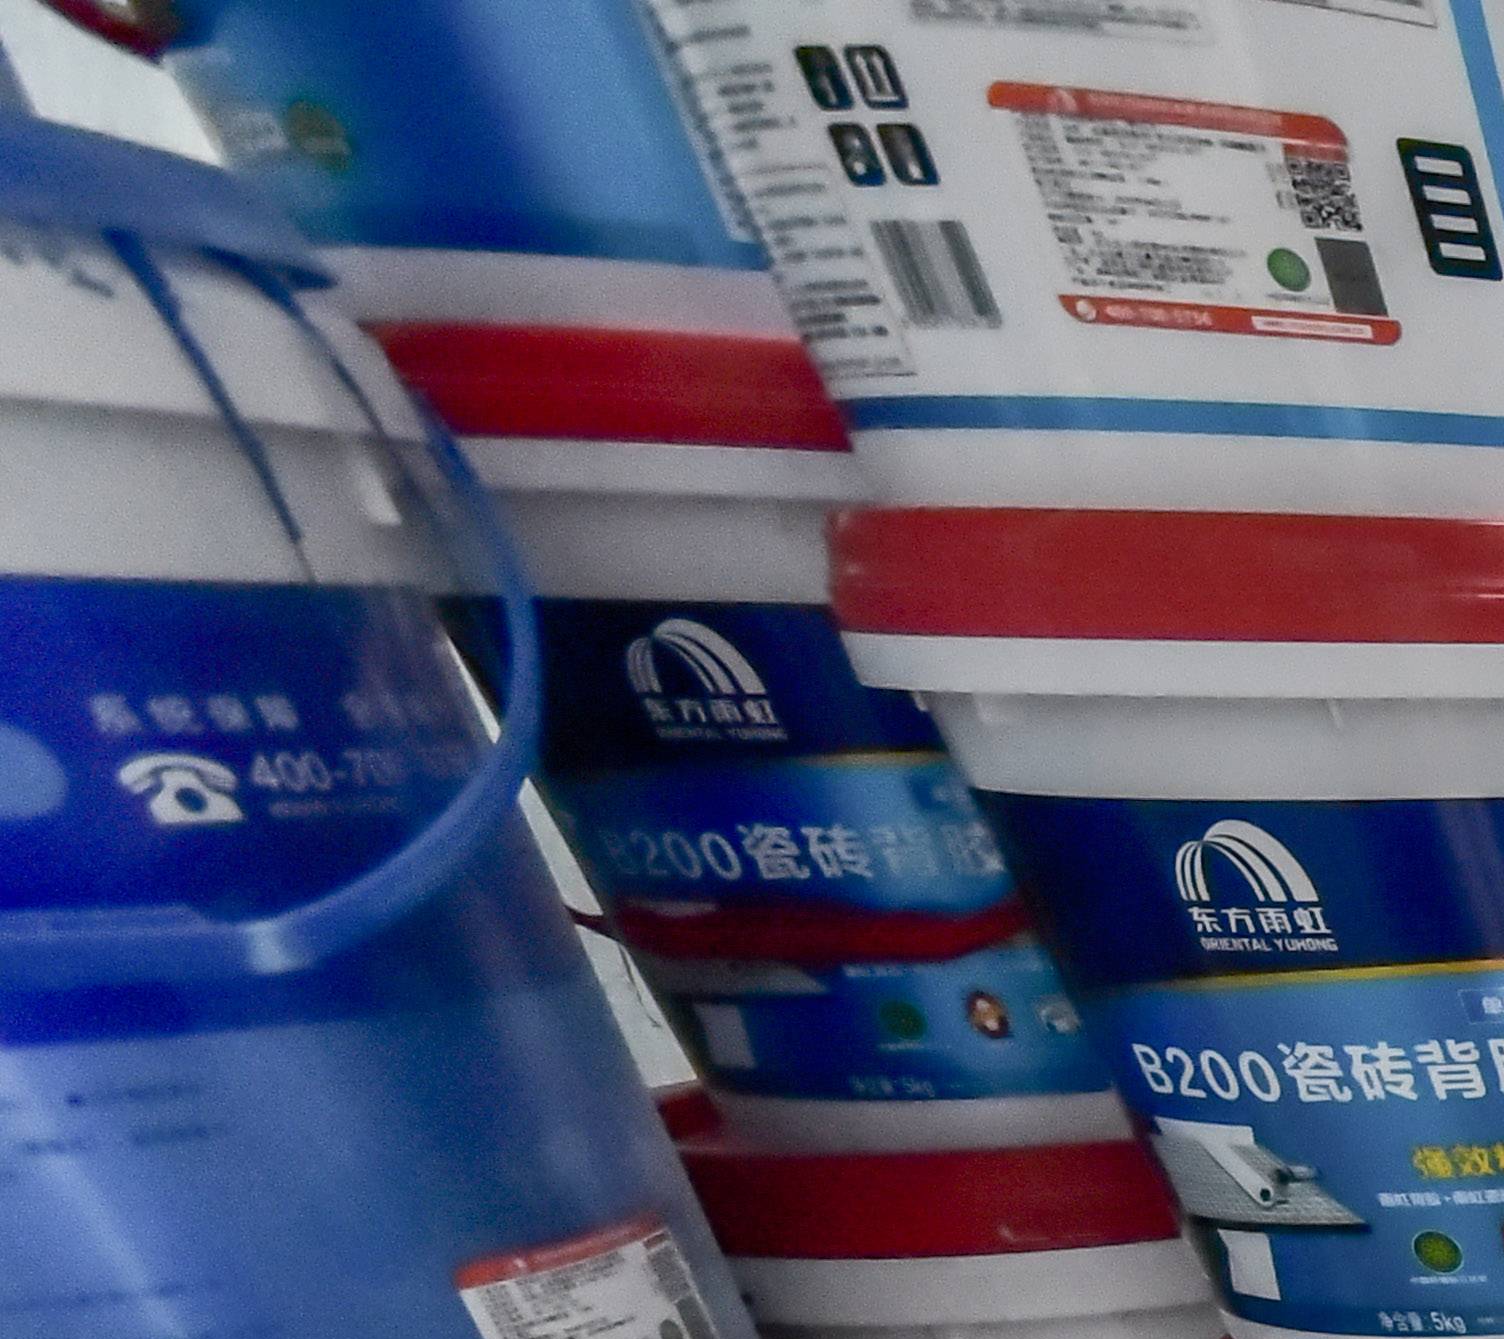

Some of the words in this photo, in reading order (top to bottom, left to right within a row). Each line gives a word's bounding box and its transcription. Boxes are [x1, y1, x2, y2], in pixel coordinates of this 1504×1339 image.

[1187, 906, 1333, 934] 东方雨虹
[1200, 937, 1272, 951] ORIENTAL
[1273, 938, 1339, 951] YUHONG
